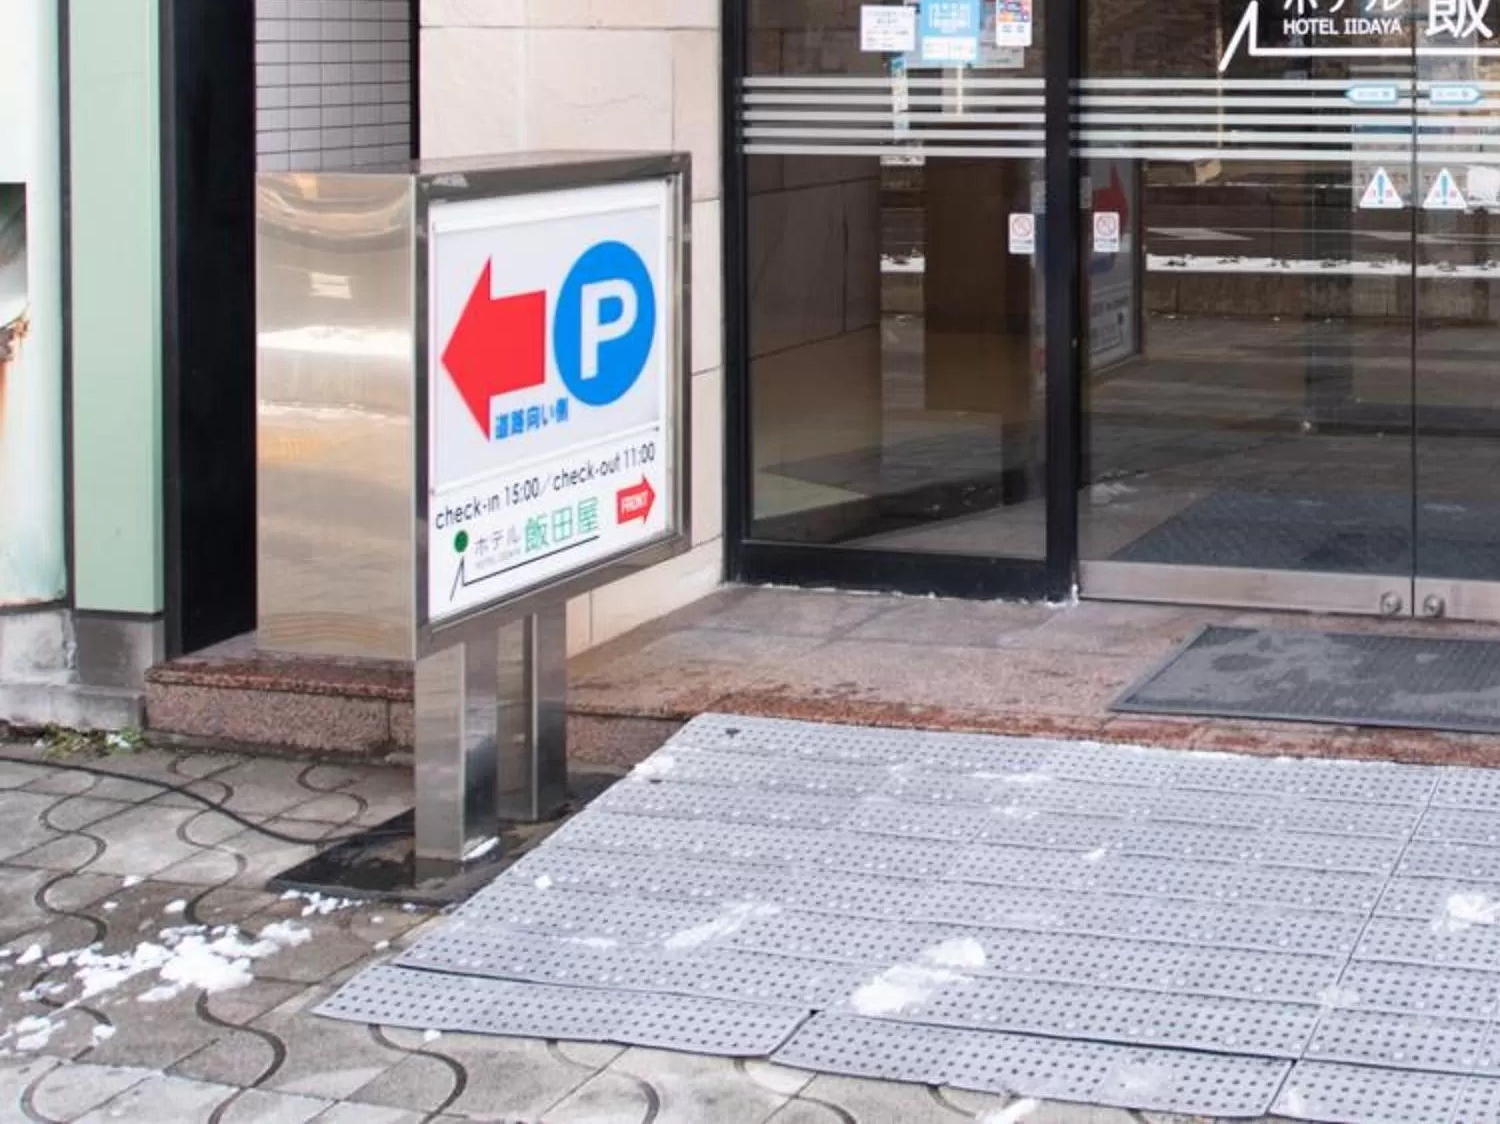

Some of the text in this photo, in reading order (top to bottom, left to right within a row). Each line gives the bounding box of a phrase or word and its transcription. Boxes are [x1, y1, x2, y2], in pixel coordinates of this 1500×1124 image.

[1283, 18, 1403, 36] HOTEL IIDAYA
[580, 277, 638, 380] P
[495, 398, 569, 440] 道路向い側
[435, 493, 500, 530] check-in
[623, 441, 656, 468] 11:00
[474, 496, 599, 556] ホテル 飯田屋
